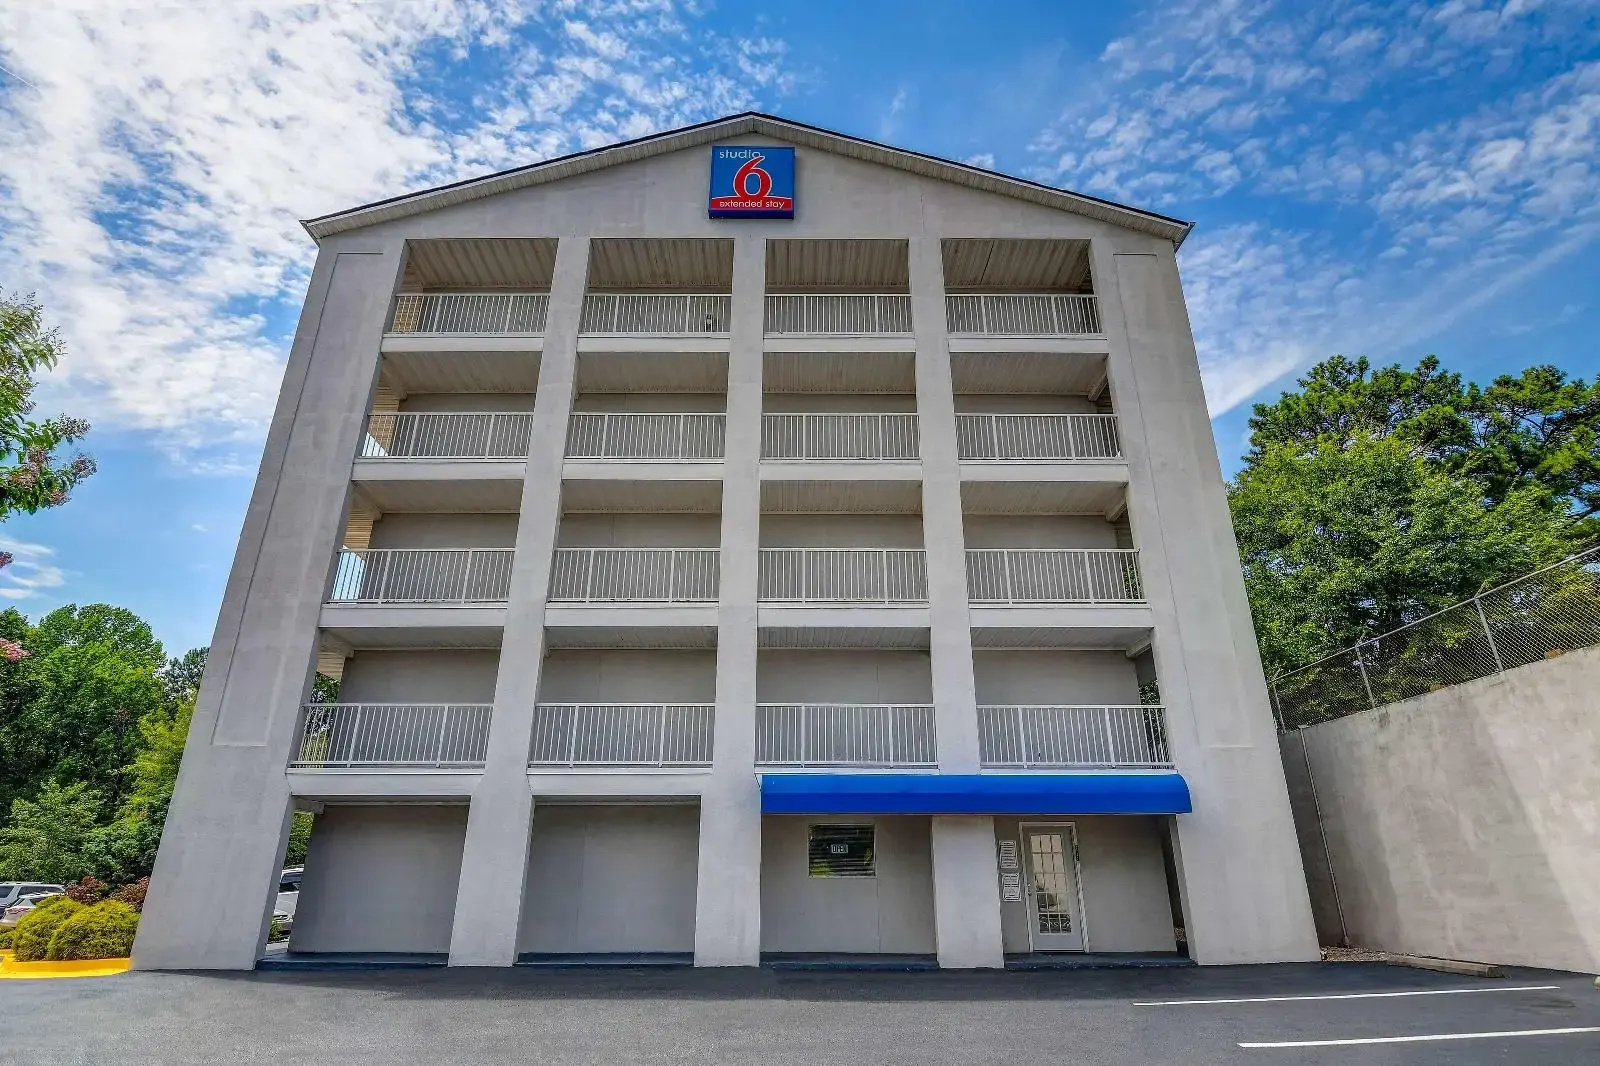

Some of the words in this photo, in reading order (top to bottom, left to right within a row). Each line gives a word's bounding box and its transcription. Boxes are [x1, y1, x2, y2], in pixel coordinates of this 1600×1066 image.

[719, 150, 761, 159] studio
[733, 155, 773, 197] 6
[719, 200, 763, 208] extended
[765, 200, 785, 209] stay
